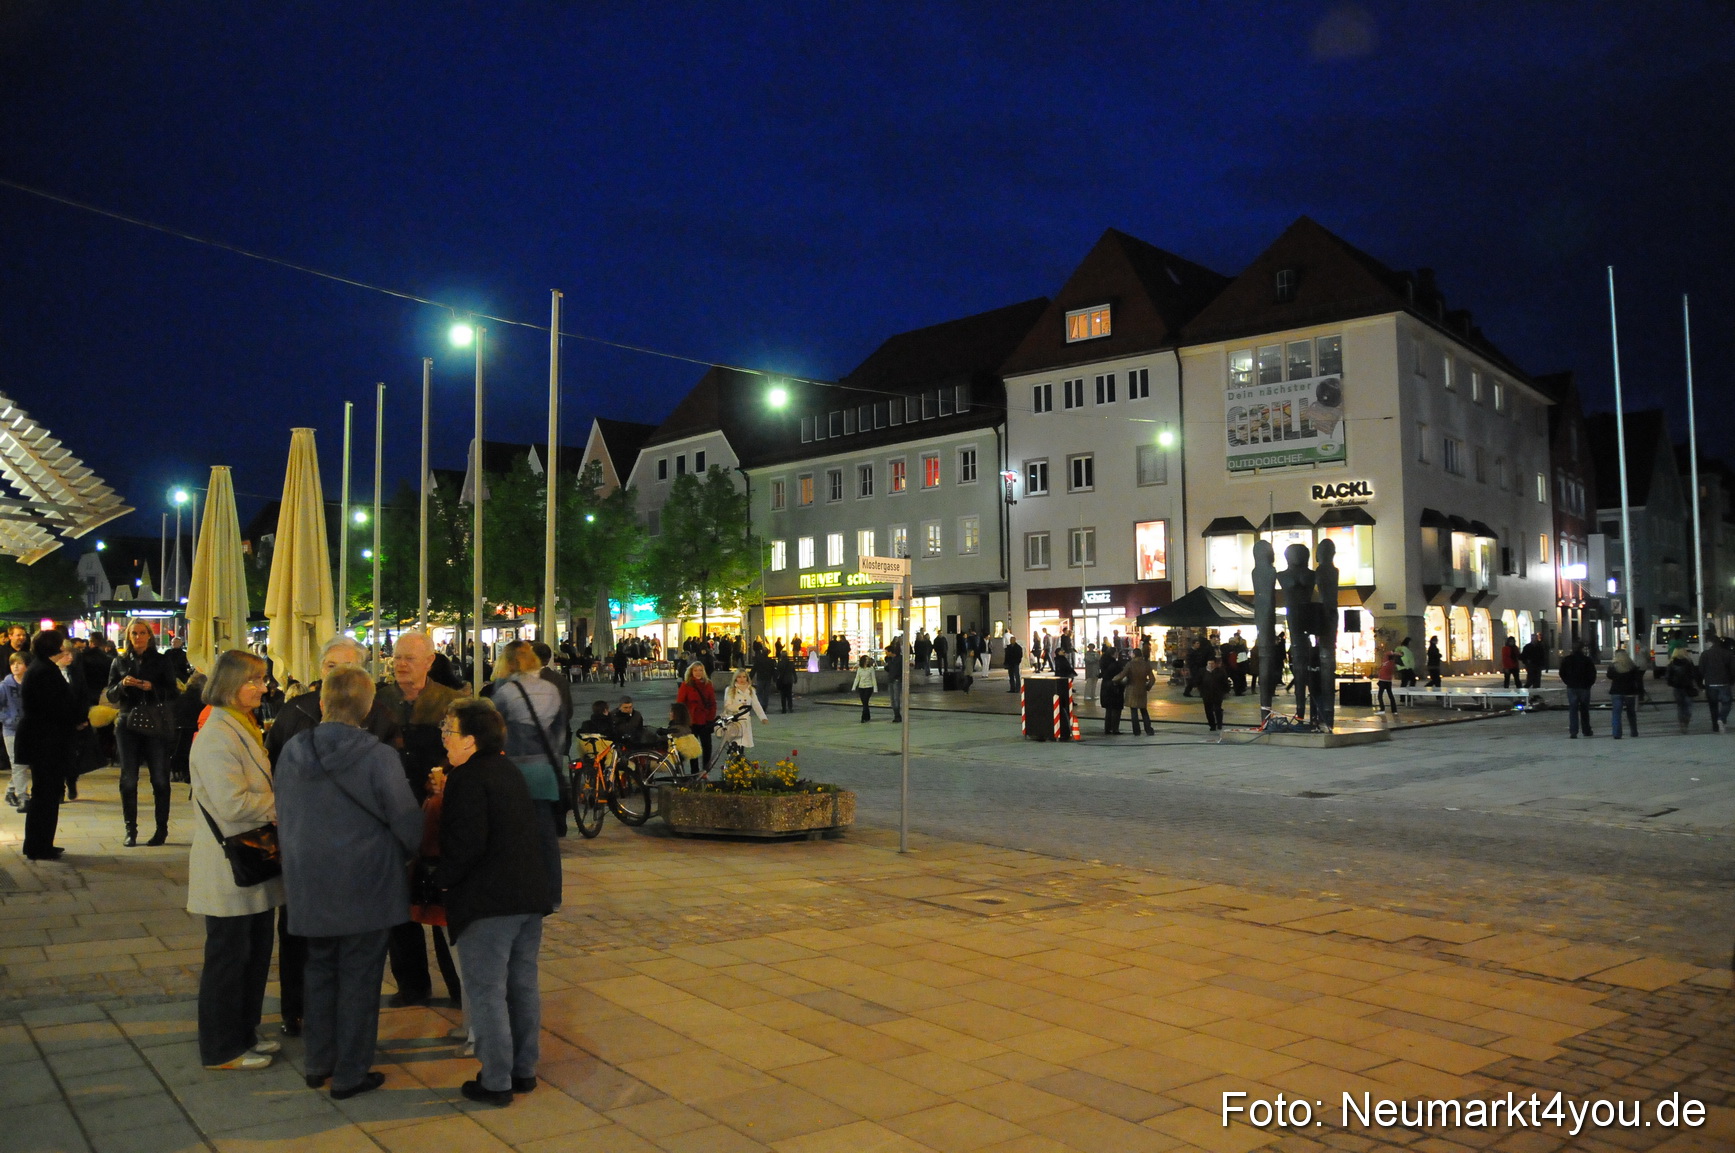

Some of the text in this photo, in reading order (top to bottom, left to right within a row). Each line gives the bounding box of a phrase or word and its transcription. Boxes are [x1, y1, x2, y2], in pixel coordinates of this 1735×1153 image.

[1228, 383, 1311, 401] Dein nächster
[1227, 397, 1318, 448] GRILL
[1228, 454, 1303, 468] OUTDOORCHEF
[1312, 481, 1374, 500] RACKL
[861, 558, 901, 573] Klostergasse
